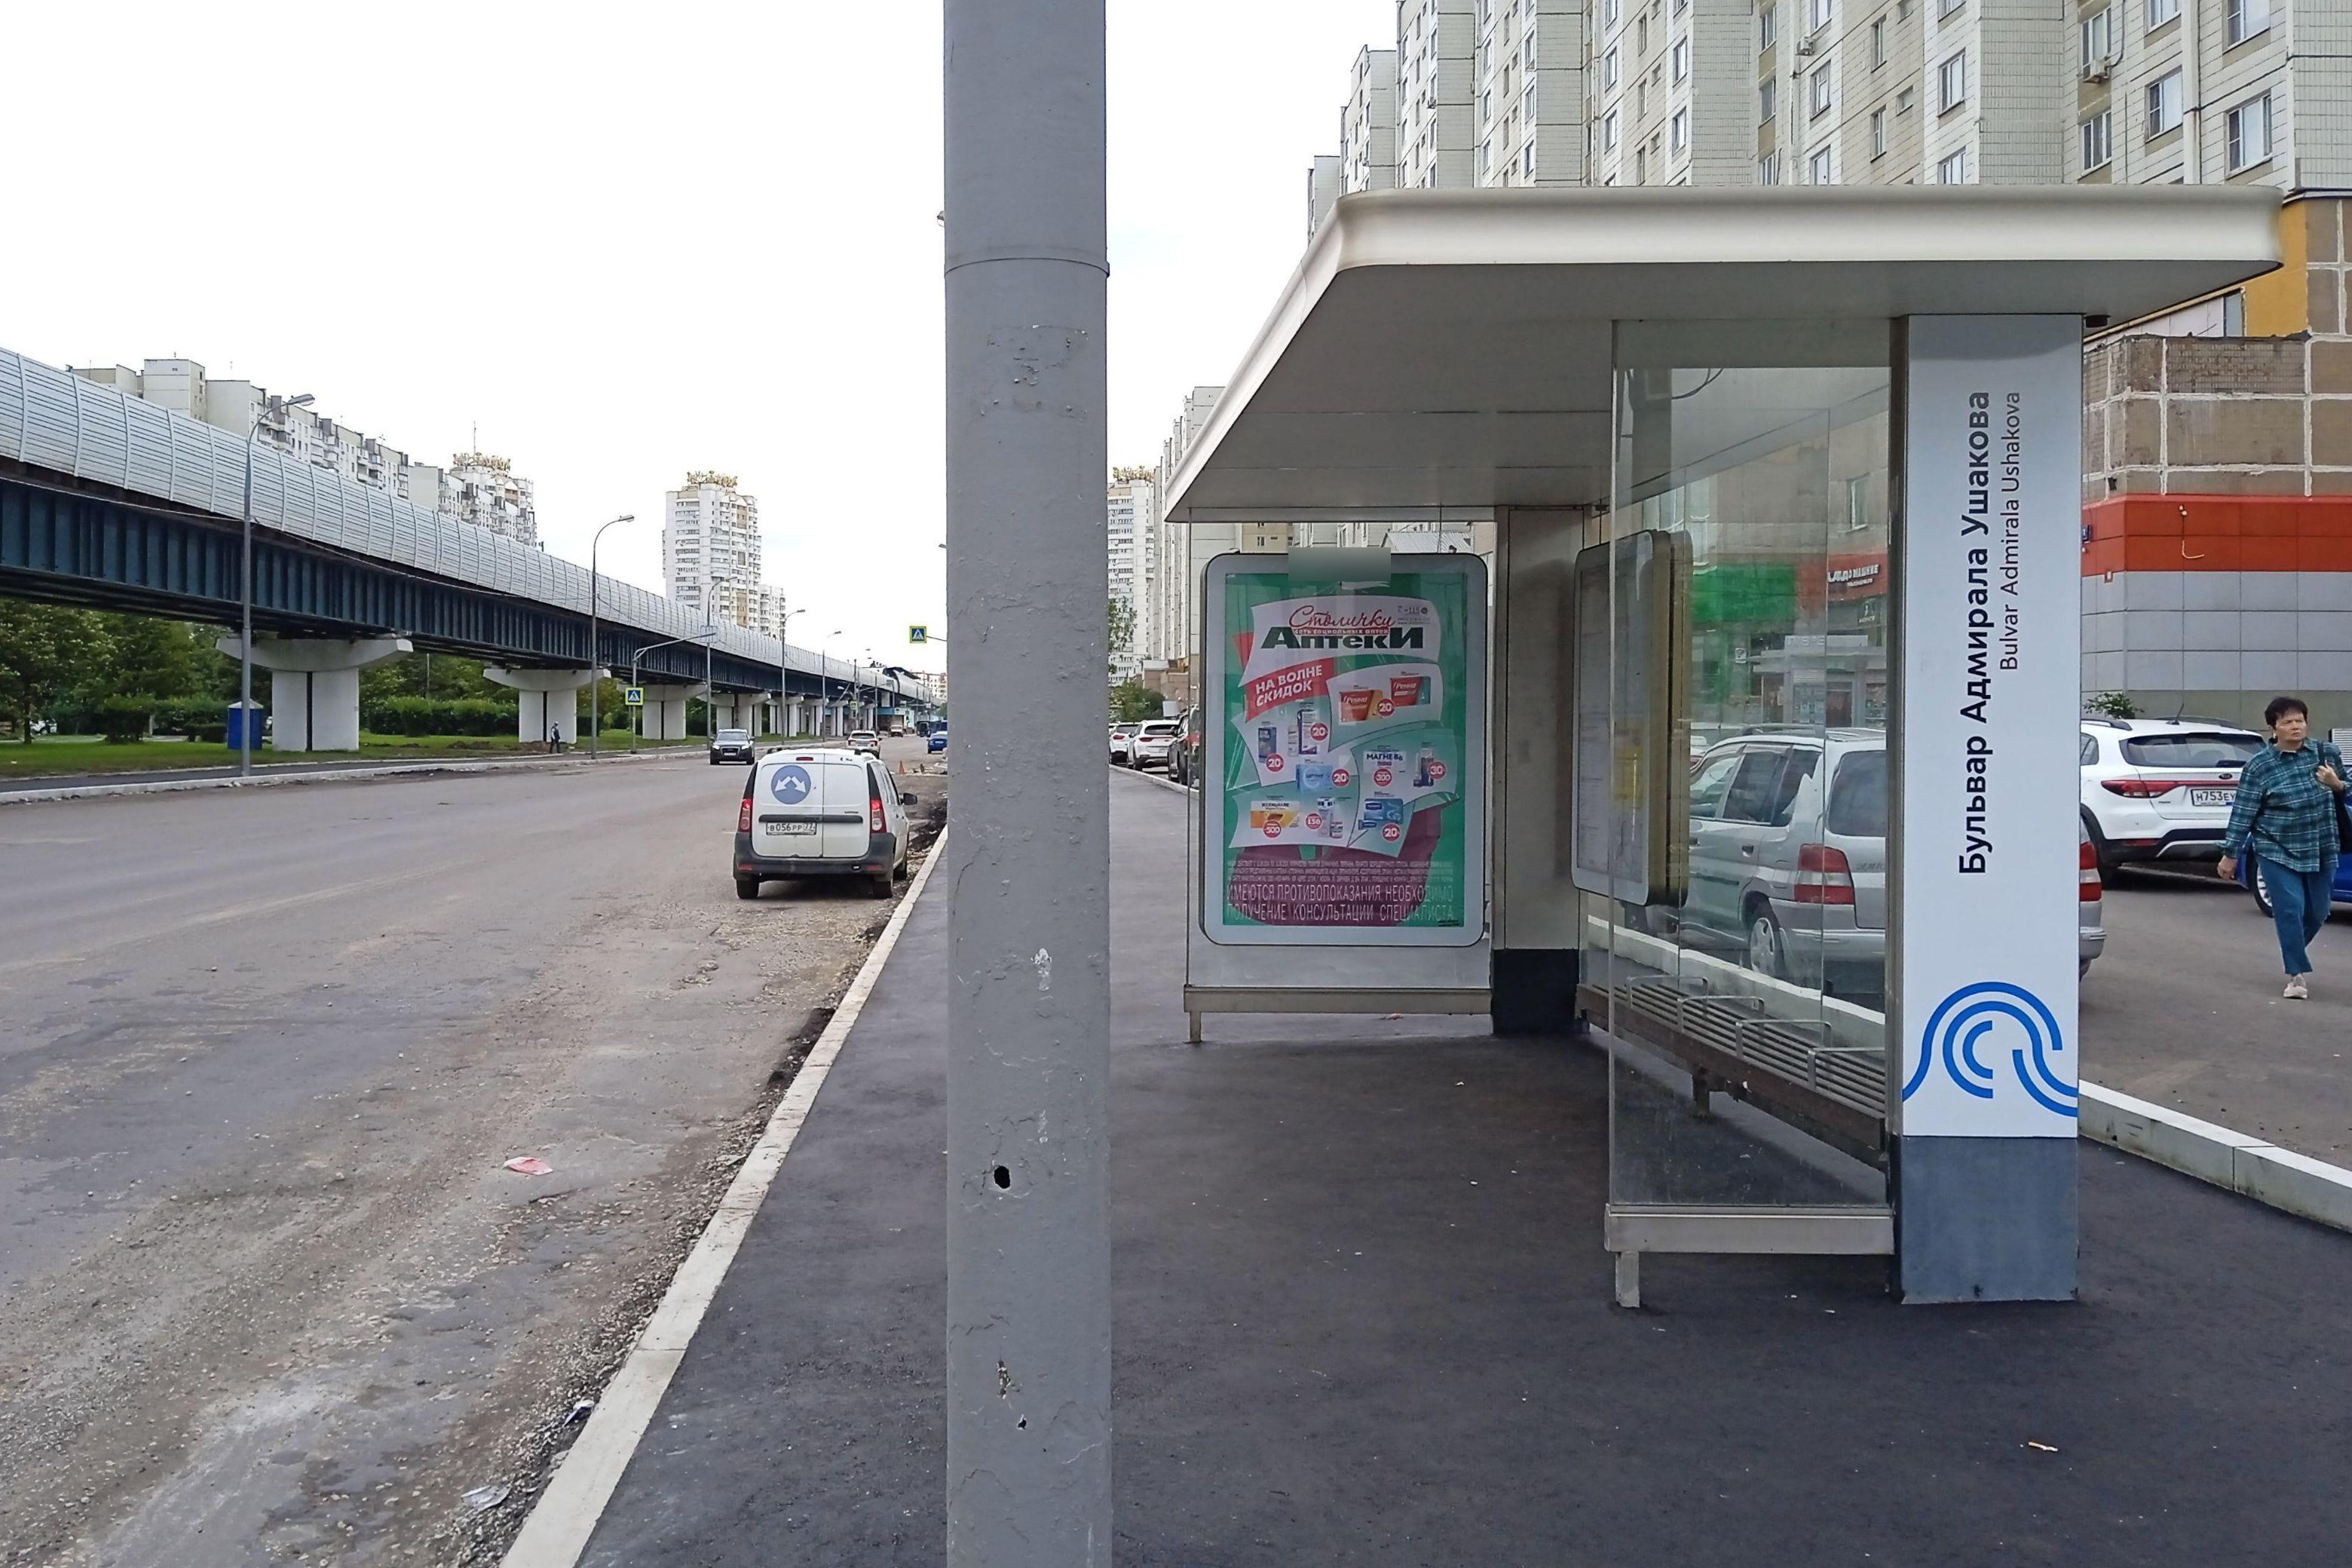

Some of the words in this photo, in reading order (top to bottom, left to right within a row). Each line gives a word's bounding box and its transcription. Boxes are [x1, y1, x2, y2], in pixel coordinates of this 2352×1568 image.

[1961, 392, 1989, 537] Ушакова
[2001, 392, 2020, 492] Ushakova
[1999, 499, 2020, 596] Admirala
[1289, 605, 1396, 627] Столички
[1960, 549, 1994, 724] Адмирала
[1999, 604, 2018, 669] Bulvar
[1255, 679, 1275, 695] НА
[1278, 664, 1323, 688] ВОЛНЕ
[1255, 680, 1313, 707] СКИДОК
[1958, 736, 1993, 874] Бульвар
[1227, 884, 1274, 901] ИМЕЮТСЯ
[1278, 884, 1381, 902] ПРОТИВОПОКАЗАНИЯ
[1386, 885, 1453, 902] НЕОБХОДИМО
[1227, 904, 1287, 920] ПОЛУЧЕНИЕ
[1293, 904, 1374, 921] КОНСУЛЬТАЦИИ
[1380, 905, 1453, 921] СПЕЦИАЛИСТА
